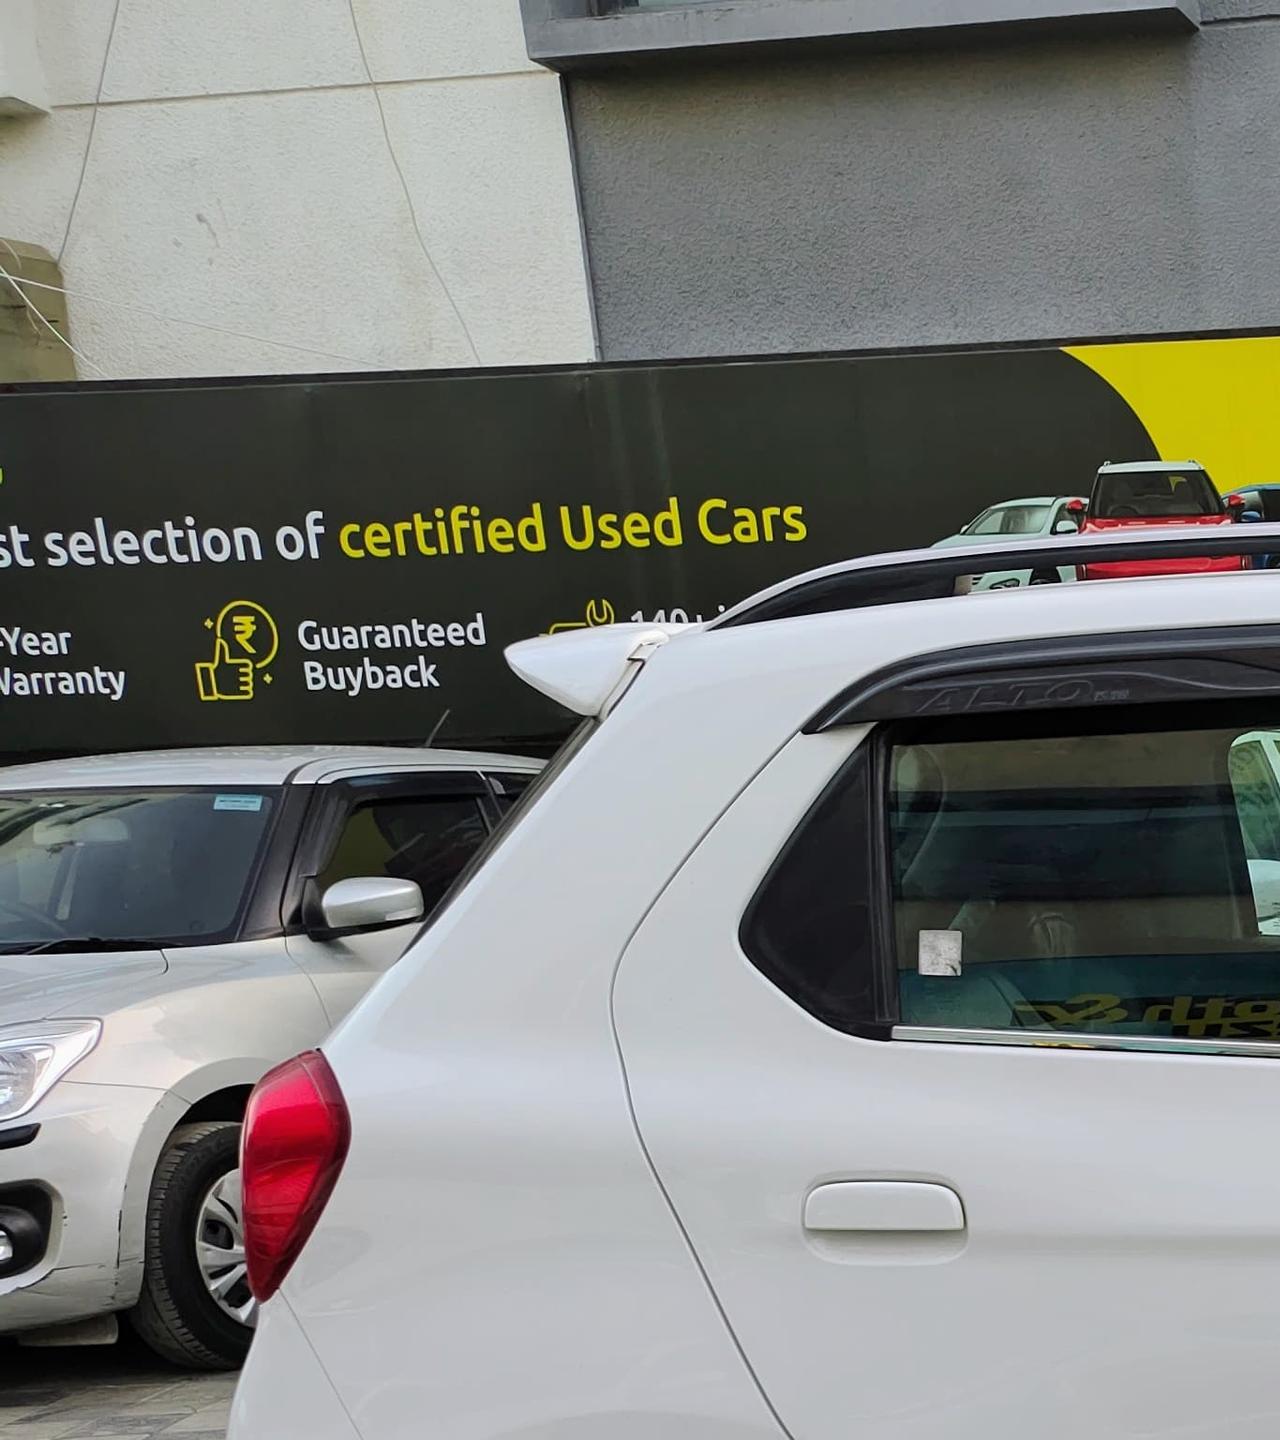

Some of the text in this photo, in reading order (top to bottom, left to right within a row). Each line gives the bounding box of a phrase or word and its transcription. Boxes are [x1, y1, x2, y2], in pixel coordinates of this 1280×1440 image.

[44, 516, 262, 567] selection
[275, 510, 325, 561] of
[339, 502, 547, 559] certified
[560, 497, 683, 551] Used
[698, 498, 808, 545] Cars
[299, 613, 486, 651] Guaranteed
[304, 655, 440, 697] Buyback
